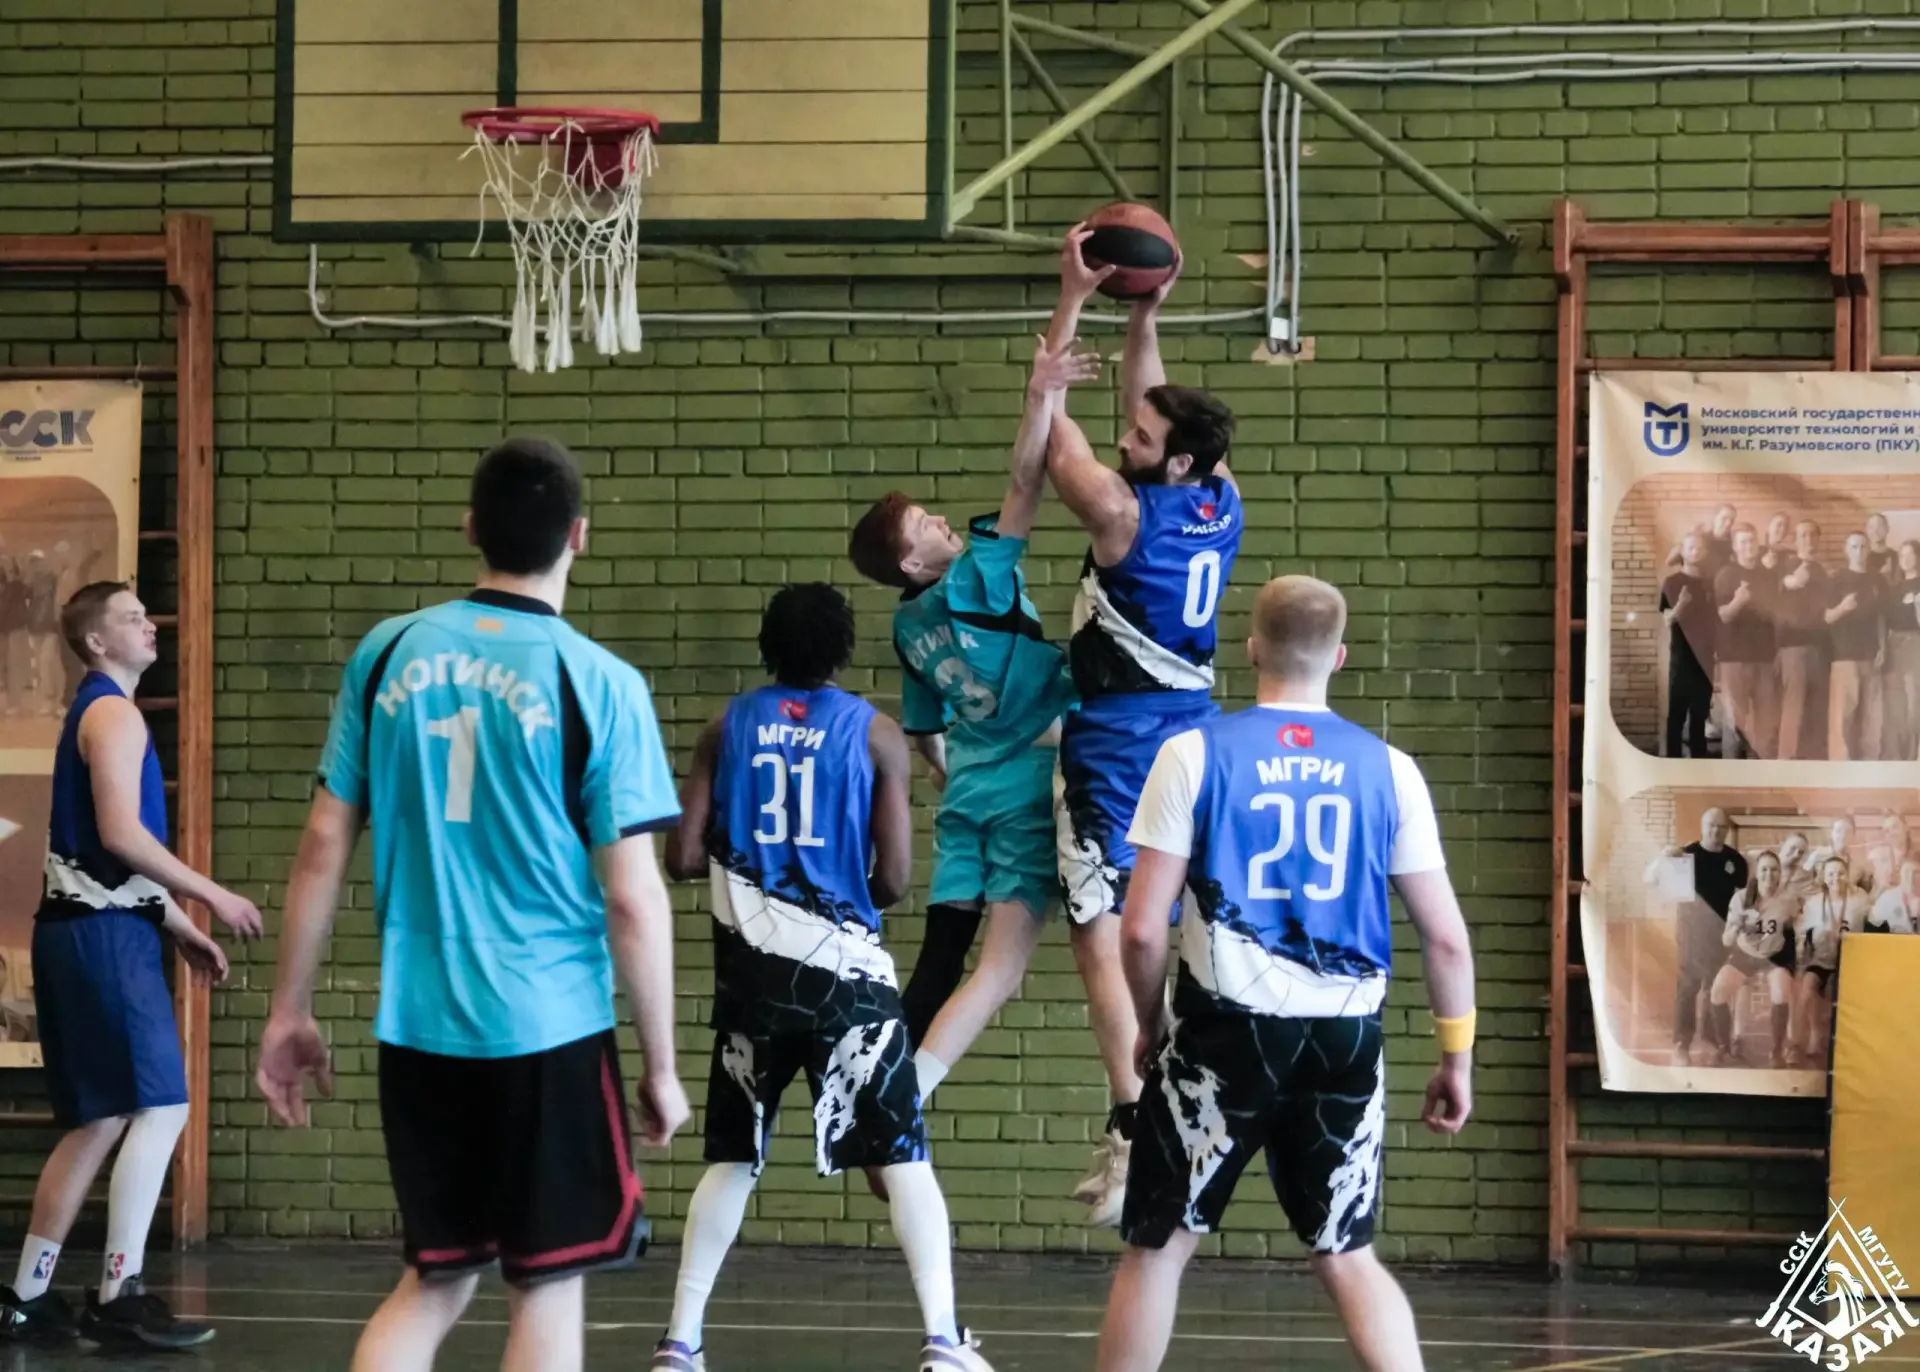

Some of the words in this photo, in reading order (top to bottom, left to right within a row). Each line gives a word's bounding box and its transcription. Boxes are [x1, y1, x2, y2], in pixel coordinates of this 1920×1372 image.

[1701, 406, 1798, 419] Московский
[1701, 424, 1801, 437] университет
[1805, 422, 1899, 435] технологий
[1904, 425, 1915, 435] и
[1703, 440, 1728, 450] им.
[1731, 439, 1755, 451] К.Г.
[1759, 440, 1871, 454] Разумовского
[1875, 439, 1920, 453] (ПКУ)
[1182, 549, 1220, 628] 0
[375, 653, 553, 739] НОГИНСК
[757, 722, 826, 750] МГРИ
[426, 705, 481, 824] 1
[1255, 755, 1346, 787] МГРИ
[751, 753, 826, 847] 31
[1247, 791, 1352, 901] 29
[1755, 919, 1778, 935] 13
